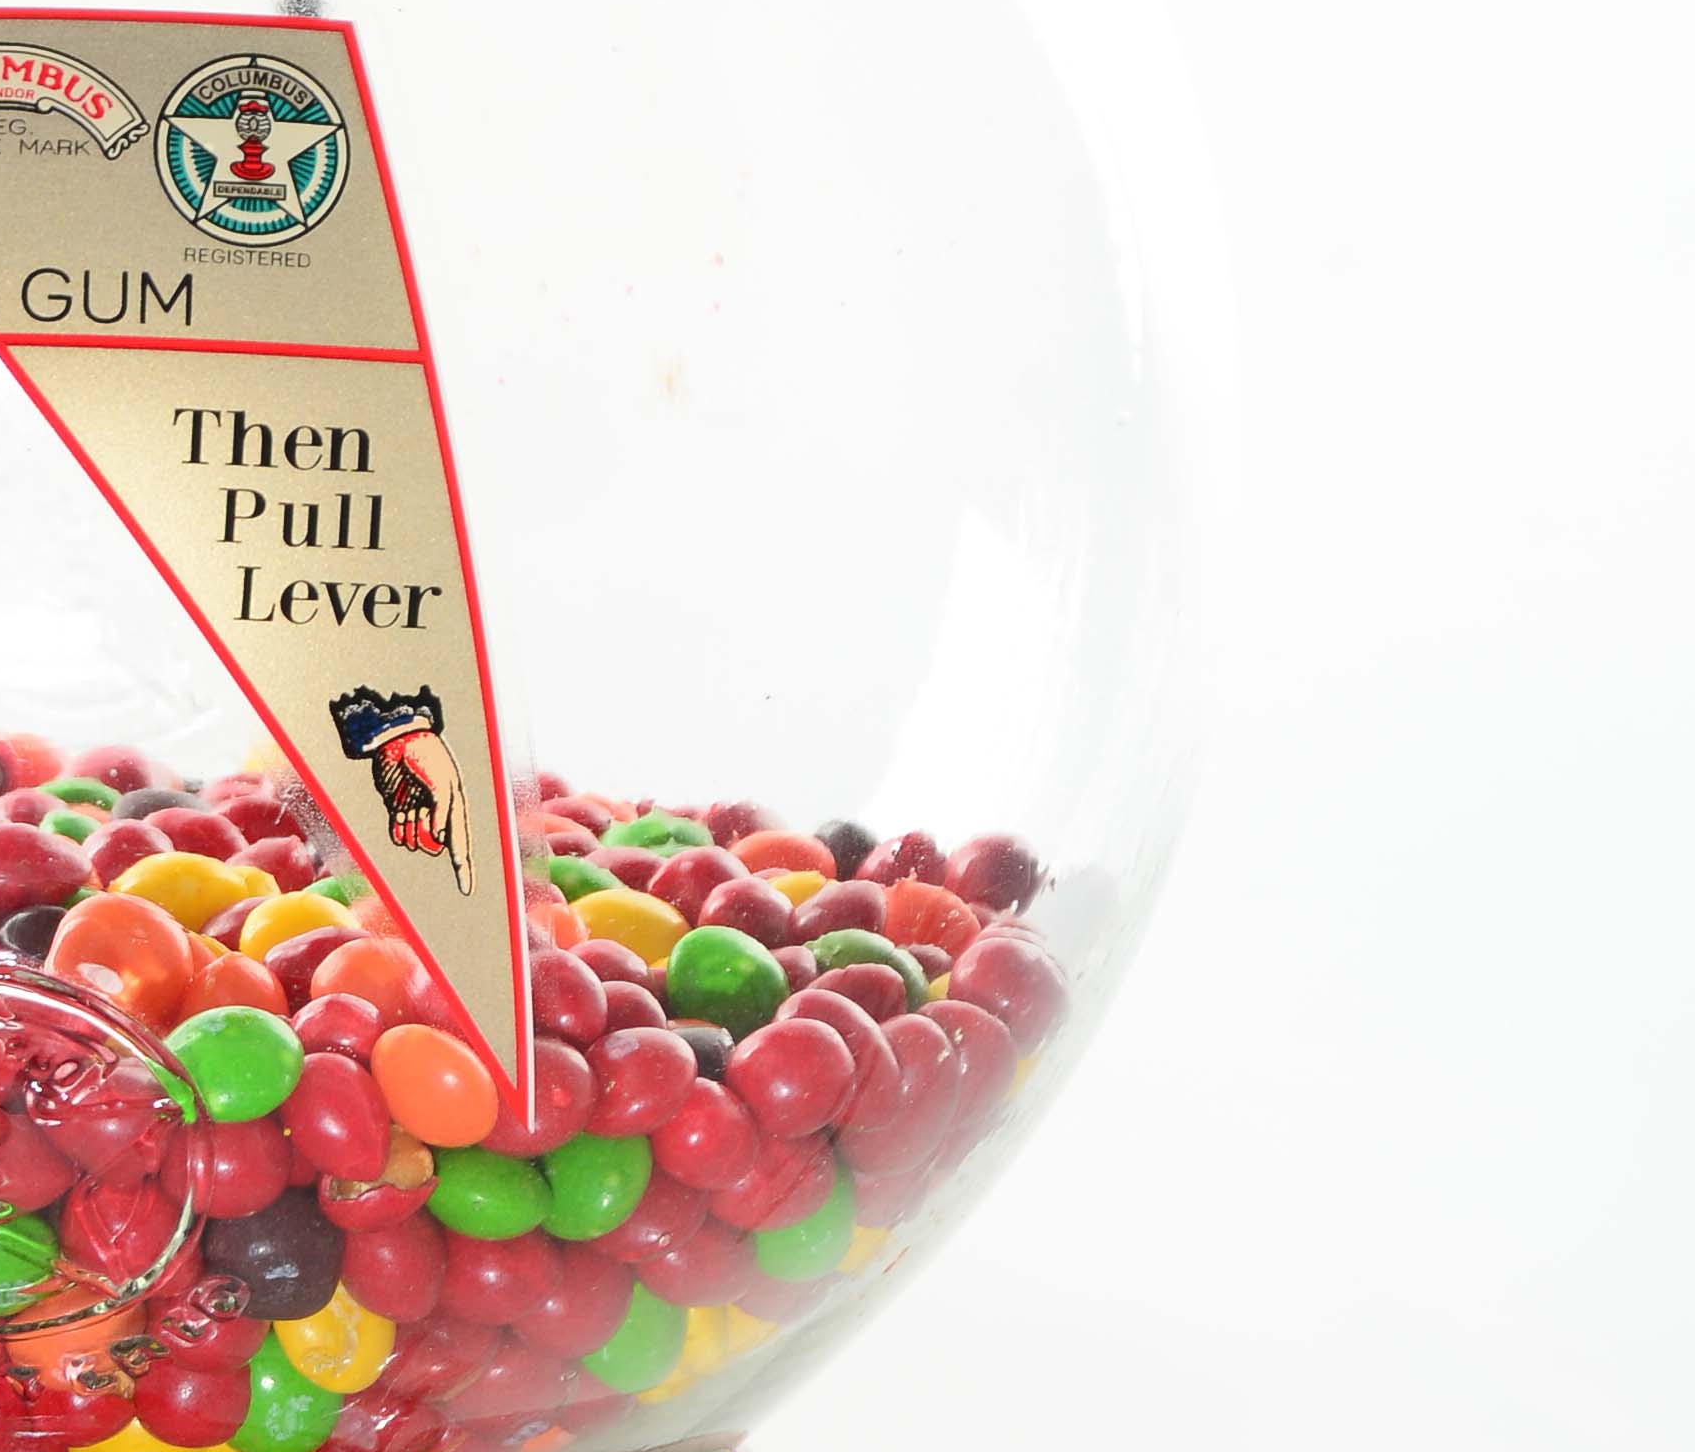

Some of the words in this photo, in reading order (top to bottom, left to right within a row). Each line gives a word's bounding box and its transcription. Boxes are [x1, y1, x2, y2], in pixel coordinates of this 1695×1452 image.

[198, 70, 309, 105] COLUMBUS
[18, 138, 90, 156] MARK
[216, 184, 284, 197] DEPENDABLE
[183, 246, 311, 268] REGISTERED
[21, 268, 193, 327] GUM
[173, 408, 374, 473] Then
[216, 487, 385, 550] Pull
[234, 566, 442, 629] Lever
